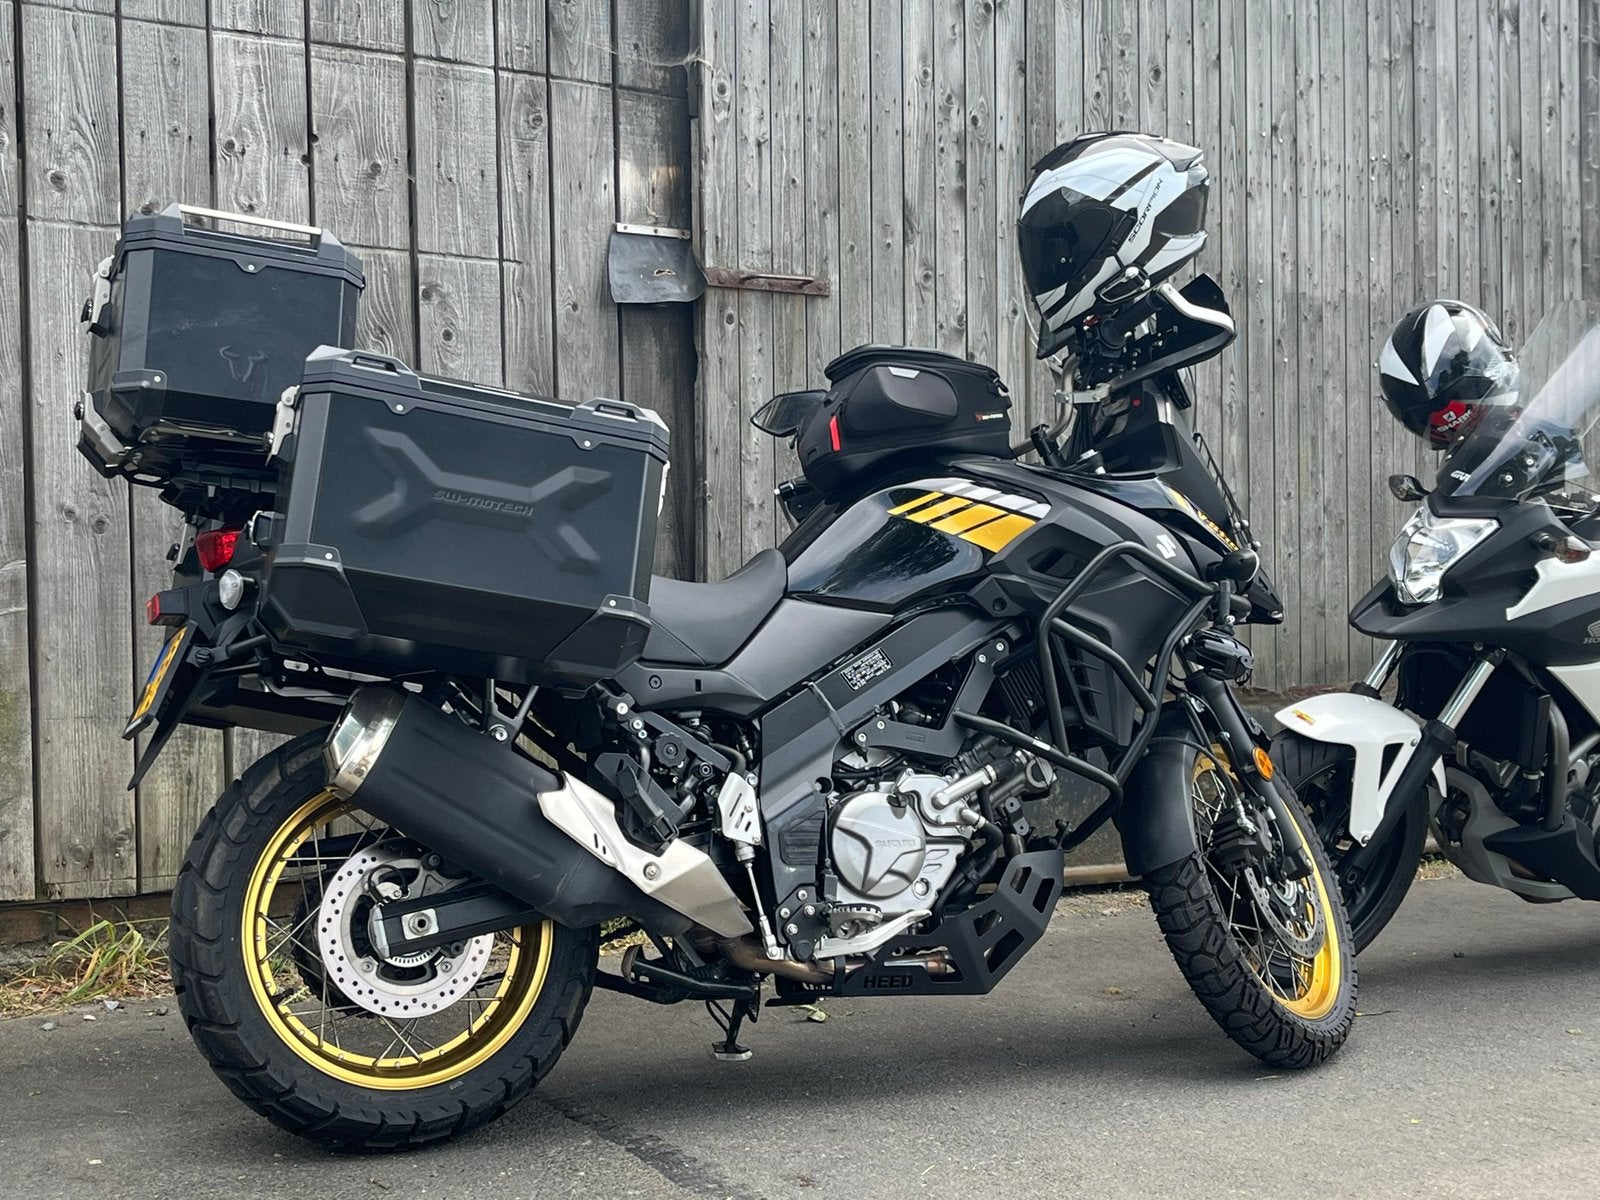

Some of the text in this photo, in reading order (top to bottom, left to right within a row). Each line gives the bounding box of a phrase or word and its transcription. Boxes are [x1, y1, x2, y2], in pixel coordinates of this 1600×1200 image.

[1128, 178, 1163, 243] SCORPION
[1437, 409, 1472, 432] SHARK
[433, 489, 534, 517] SW-MOTECH
[875, 839, 917, 848] SUZUKI
[863, 974, 914, 989] HEED
